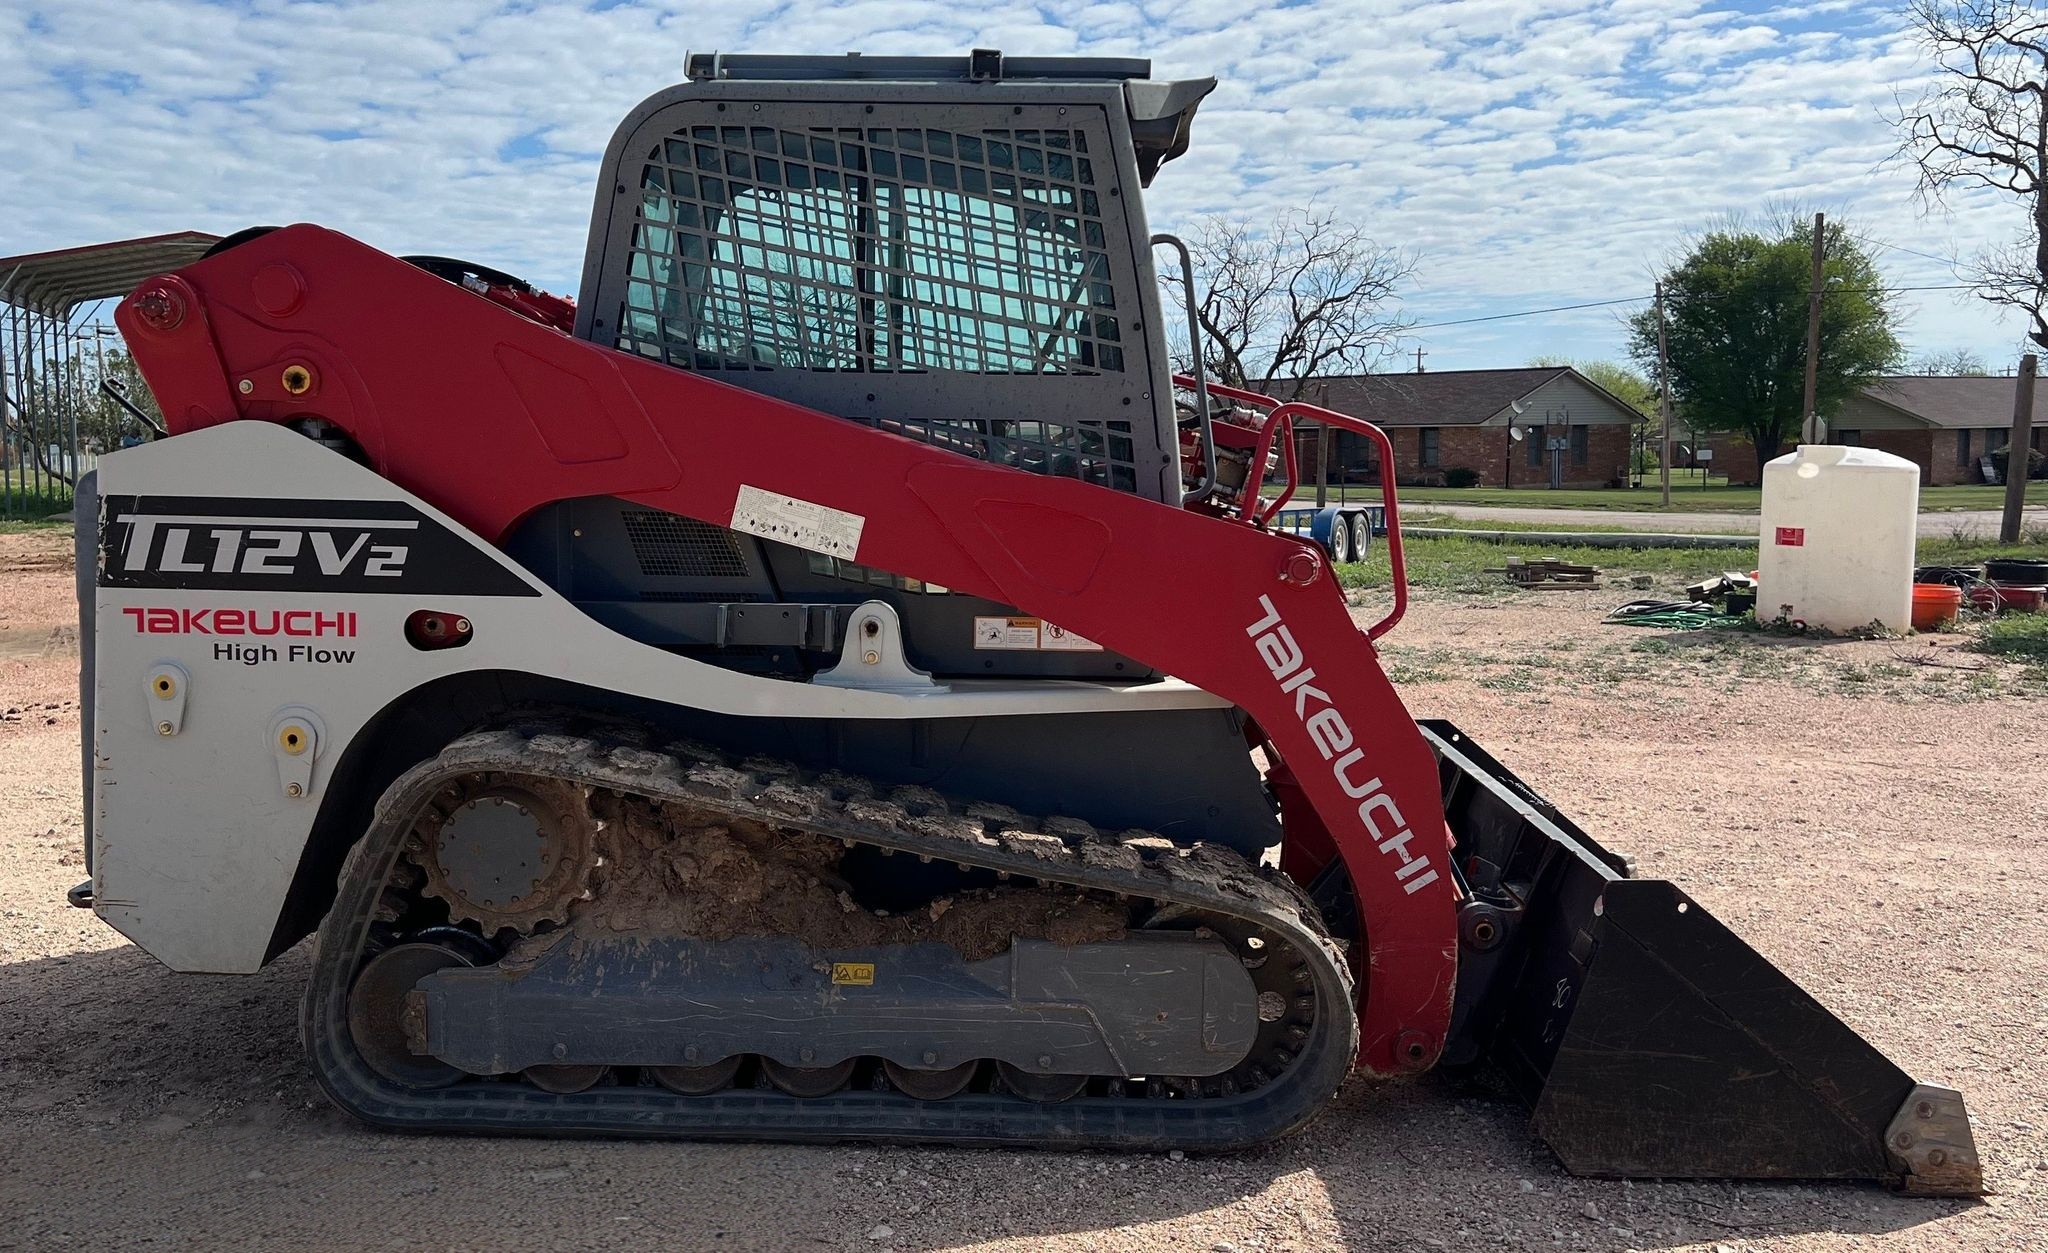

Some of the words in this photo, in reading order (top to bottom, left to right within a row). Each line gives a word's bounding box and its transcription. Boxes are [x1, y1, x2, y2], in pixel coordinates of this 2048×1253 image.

[122, 607, 357, 637] TAKEUCHI
[213, 643, 277, 666] High
[289, 645, 356, 664] Flow
[1245, 593, 1439, 896] TAKEUCHI
